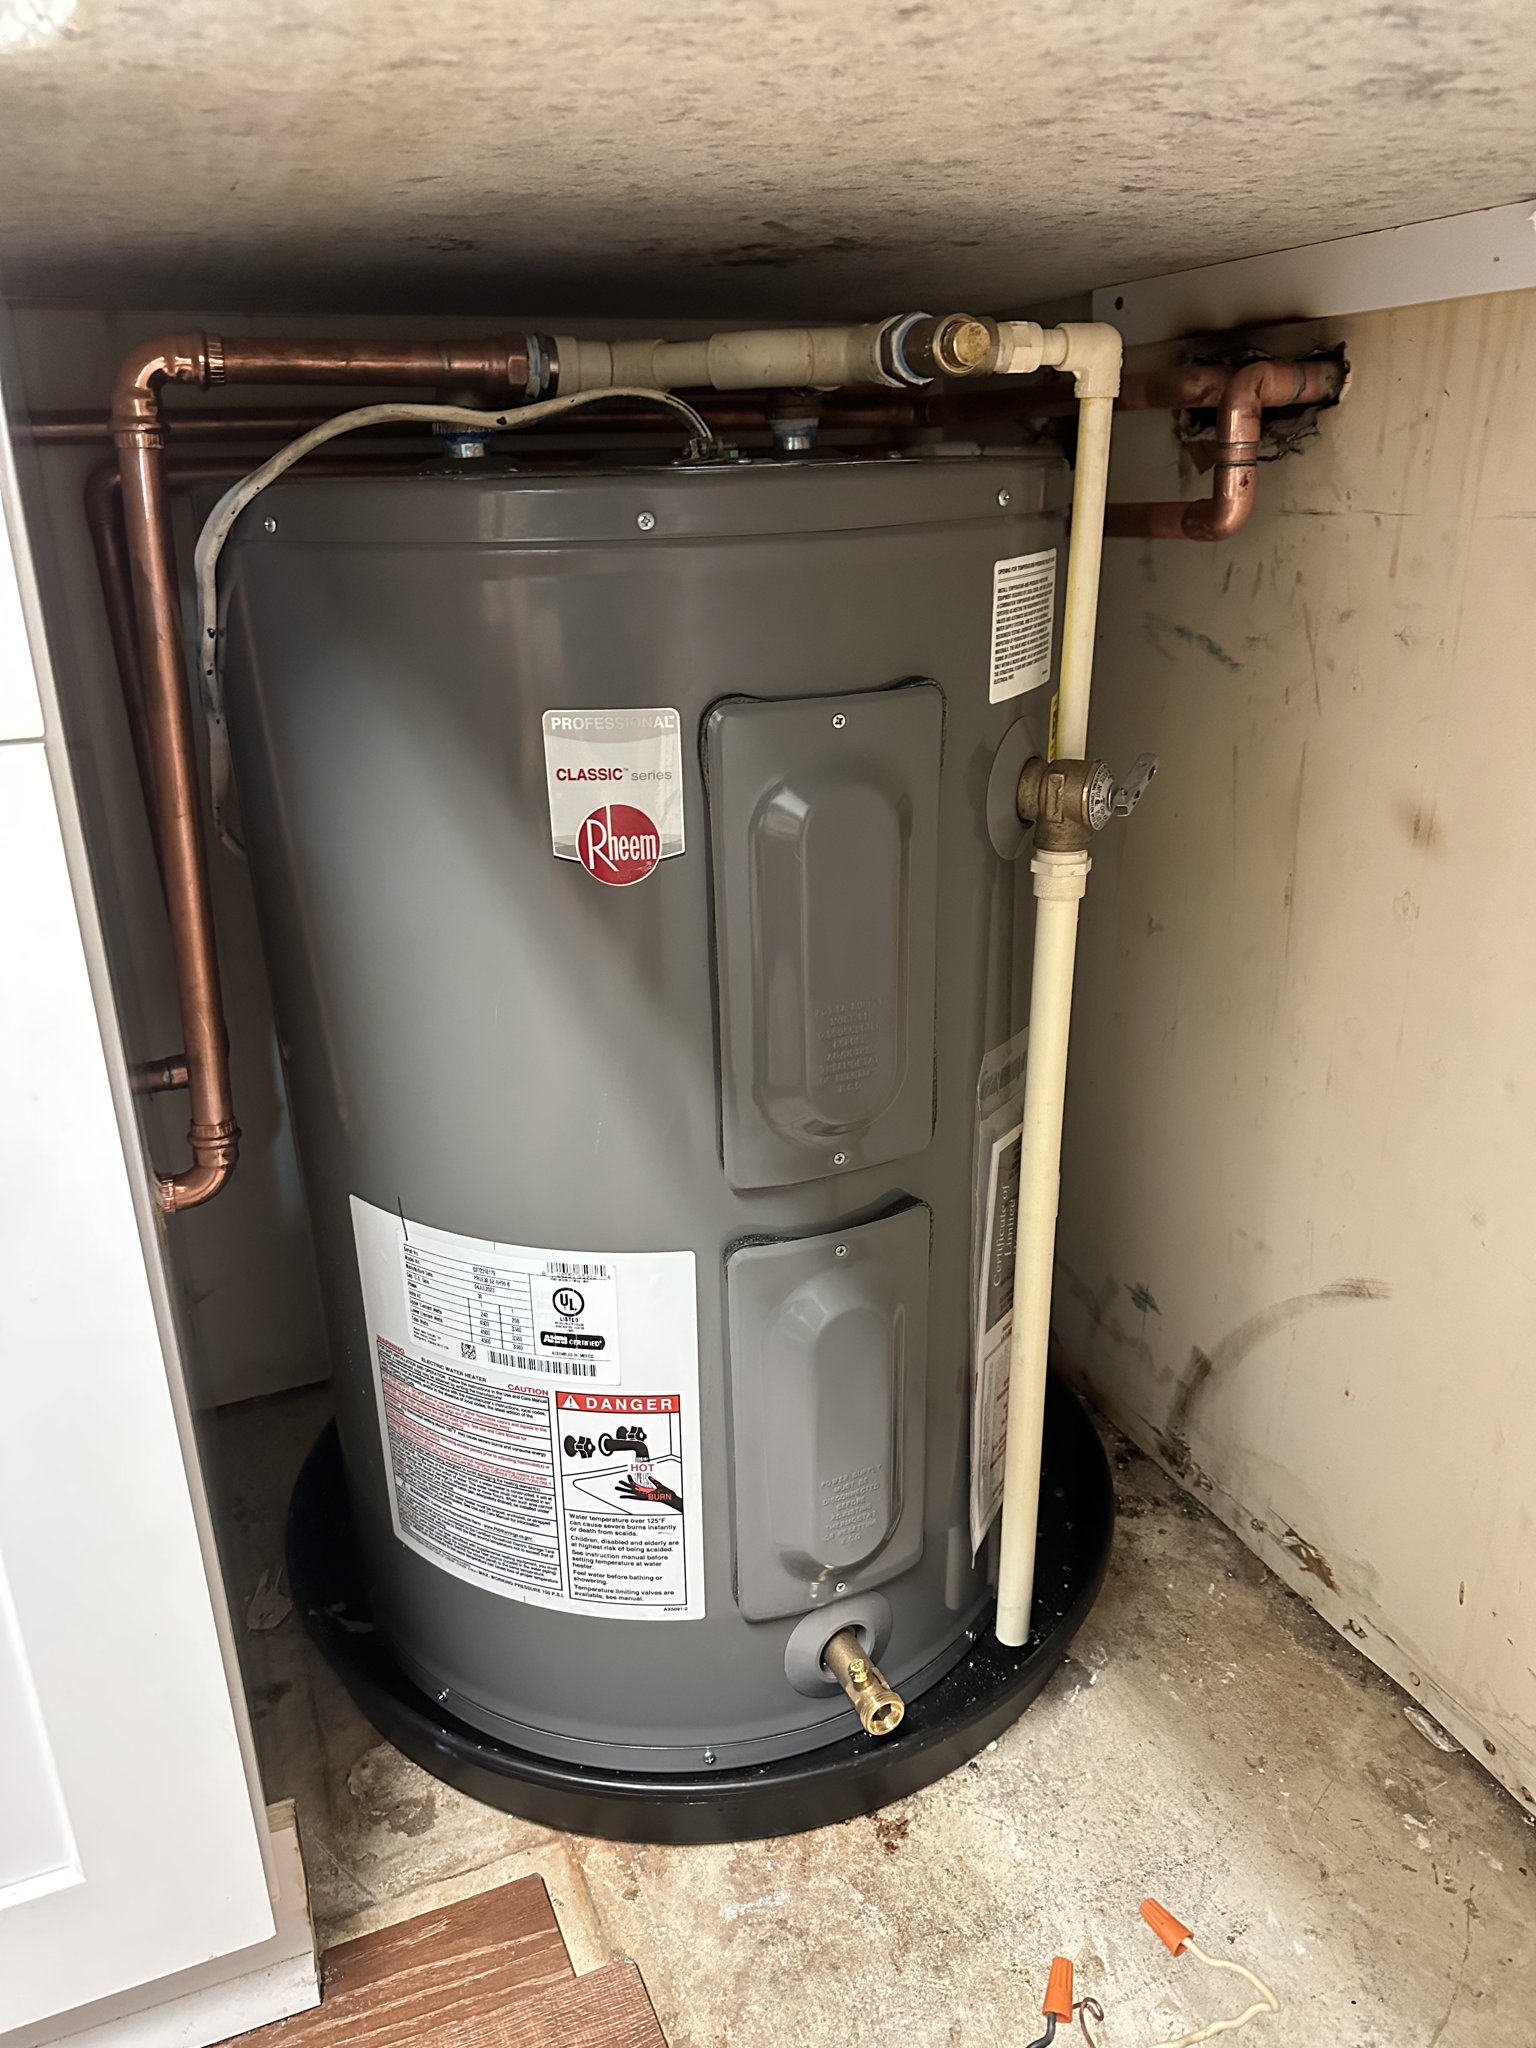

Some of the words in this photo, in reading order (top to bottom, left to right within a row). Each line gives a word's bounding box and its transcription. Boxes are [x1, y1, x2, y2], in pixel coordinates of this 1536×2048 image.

[631, 770, 672, 781] series
[586, 804, 657, 872] Rheem
[993, 1204, 1006, 1286] Certificate
[421, 1357, 444, 1370] ELECTRIC
[444, 1366, 463, 1377] WATER
[464, 1372, 486, 1383] HEATER
[507, 1384, 548, 1396] CAUTION
[586, 1397, 672, 1410] DANGER
[630, 1464, 655, 1472] HOT
[589, 1516, 628, 1524] temperature
[571, 1535, 600, 1544] Children,
[579, 1542, 603, 1550] highest
[585, 1550, 620, 1559] instruction
[572, 1556, 594, 1564] setting
[595, 1558, 634, 1566] temperature
[478, 1570, 490, 1578] MAX.
[490, 1575, 513, 1585] WORKING
[514, 1582, 540, 1593] PRESSURE
[574, 1576, 608, 1585] showering.
[574, 1584, 614, 1593] Temperature
[616, 1588, 640, 1596] limiting
[575, 1591, 604, 1599] available,
